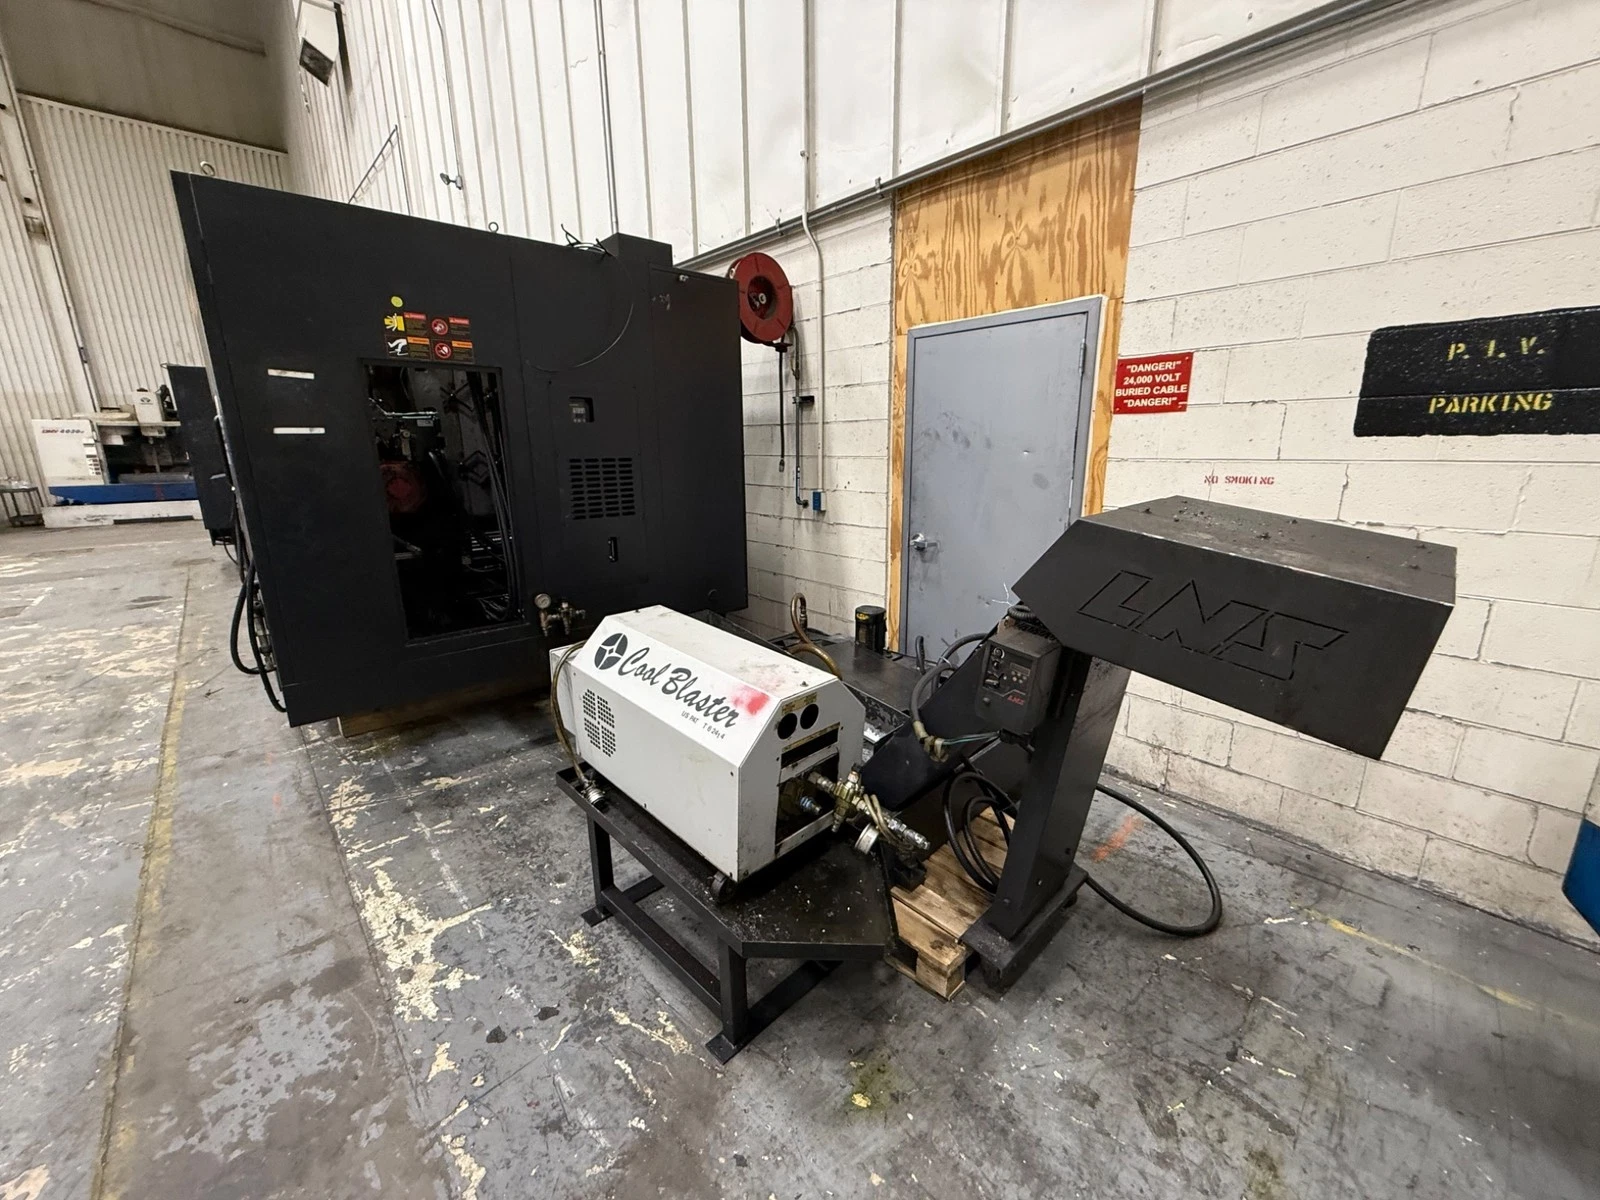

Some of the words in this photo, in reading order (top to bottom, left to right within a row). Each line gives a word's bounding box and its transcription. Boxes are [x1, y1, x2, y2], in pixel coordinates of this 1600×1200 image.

[1126, 361, 1182, 373] "DANGER!"
[1123, 375, 1153, 386] 24,000
[1155, 372, 1182, 383] VOLT
[1115, 386, 1151, 397] BURIED
[1152, 384, 1188, 395] CABLE
[1123, 396, 1178, 408] "DANGER!"
[1428, 393, 1553, 414] PARKING
[1204, 475, 1219, 485] NO
[1224, 475, 1275, 485] SMOKING
[1077, 569, 1349, 681] LNS
[617, 647, 671, 686] Cool
[661, 667, 740, 729] Blaster
